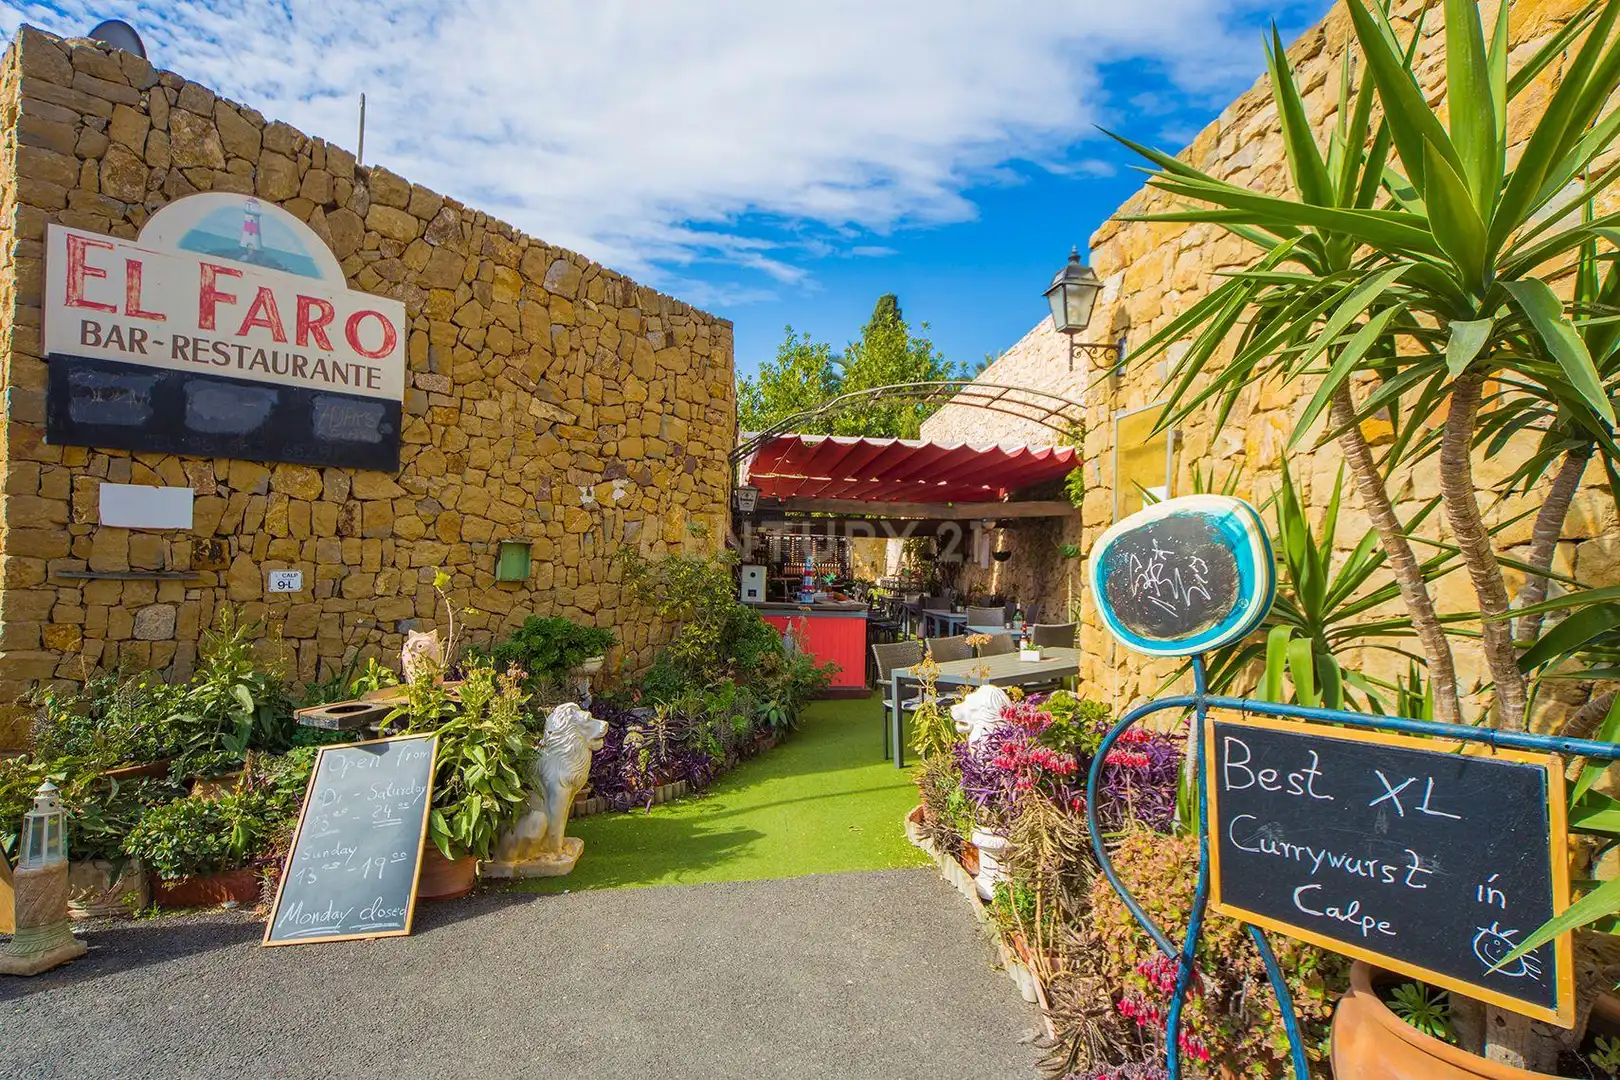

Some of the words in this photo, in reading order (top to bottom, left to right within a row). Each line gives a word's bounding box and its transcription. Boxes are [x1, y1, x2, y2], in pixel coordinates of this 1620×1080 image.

[64, 233, 167, 322] EL
[198, 261, 397, 360] FARO
[329, 754, 380, 777] Open
[396, 745, 432, 767] from
[1223, 737, 1334, 800] Best
[1369, 769, 1461, 819] XL
[366, 778, 427, 803] Saturday
[301, 842, 358, 866] Sunday
[1229, 814, 1433, 889] Currywurst
[1476, 874, 1506, 909] in
[278, 899, 354, 929] Monday
[359, 894, 410, 923] closed
[1293, 883, 1397, 938] Calpe
